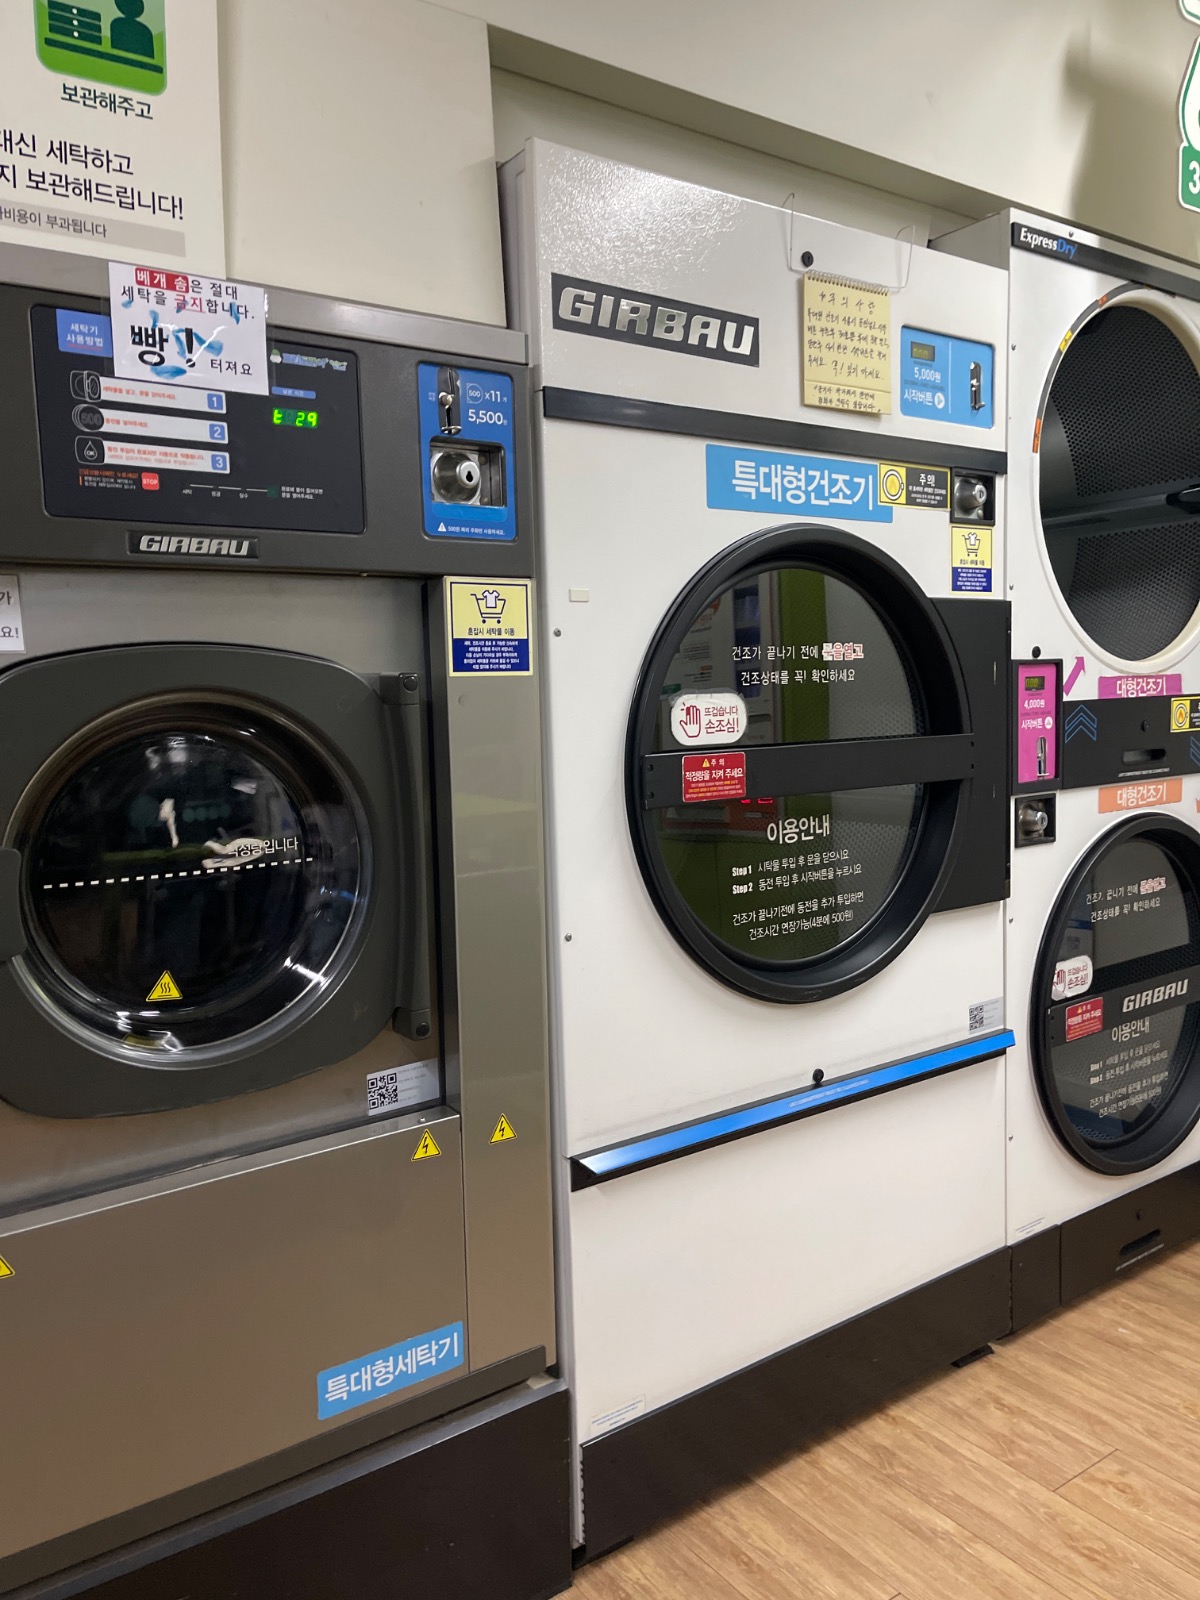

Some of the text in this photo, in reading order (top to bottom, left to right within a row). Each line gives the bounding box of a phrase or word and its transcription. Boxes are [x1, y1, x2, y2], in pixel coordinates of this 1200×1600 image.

[61, 83, 154, 120] 보관해주고
[46, 140, 134, 175] 세탁하고
[26, 169, 183, 220] 보관해드립니다!
[46, 214, 107, 238] 부과됩니다
[1020, 227, 1077, 259] ExpressDry
[210, 282, 238, 300] 절대
[121, 286, 255, 319] 세탁을 금지합니다.
[71, 323, 98, 336] 세탁기
[558, 286, 755, 356] GIRBAU
[66, 333, 103, 347] 사용방법
[210, 359, 252, 375] 터져요
[914, 367, 941, 383] 5,000원
[212, 397, 217, 407] 1
[904, 388, 933, 405] 시작버튼
[213, 427, 221, 438] 2
[216, 457, 223, 468] 3
[732, 459, 873, 511] 특대형건조기
[139, 535, 250, 557] GIRBAU
[468, 627, 515, 636] 혼잡시 세탁물 이동
[732, 646, 761, 660] 건조가
[766, 645, 795, 660] 끝나기
[800, 645, 818, 659] 전에
[741, 669, 855, 686] 건조상태를 꼭! 확인하세요
[1117, 676, 1166, 697] 대형건조기
[704, 705, 738, 717] 뜨겁습니다
[1024, 699, 1045, 709] 4,000원
[704, 718, 739, 734] 손조심!
[1021, 718, 1043, 730] 시작버튼
[685, 768, 744, 781] 적정량을 지켜 주세요
[1117, 783, 1166, 807] 대형건조기
[767, 814, 830, 844] 이용안내
[781, 857, 796, 870] 투입
[798, 855, 805, 867] 후
[807, 853, 820, 865] 문을
[758, 878, 773, 891] 동전
[775, 875, 789, 887] 투입
[791, 873, 799, 885] 후
[801, 867, 835, 884] 시작버튼을
[733, 890, 864, 926] 건조가 끝나기전에 동전을 추가 투입하면
[749, 924, 779, 940] 건조시간
[1123, 979, 1188, 1012] GIRBAU
[1111, 1016, 1149, 1042] 이용안내
[325, 1332, 458, 1402] 특대형세탁기
